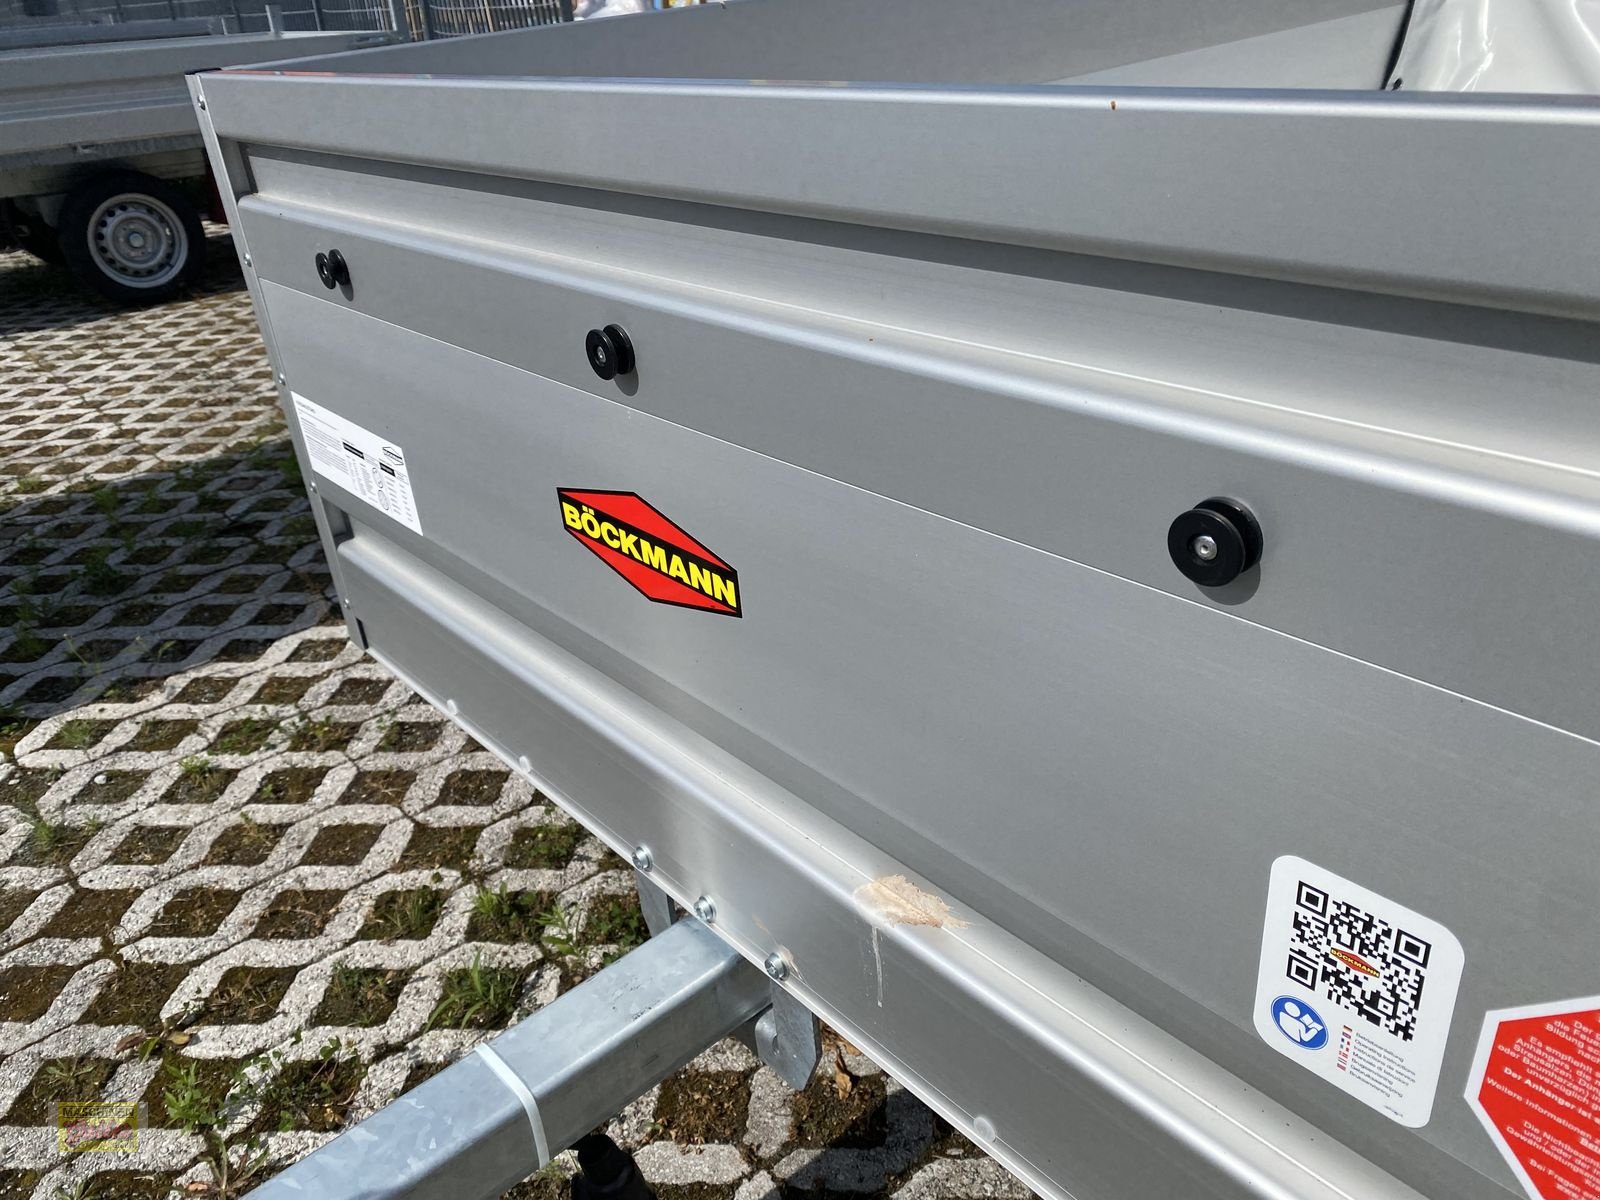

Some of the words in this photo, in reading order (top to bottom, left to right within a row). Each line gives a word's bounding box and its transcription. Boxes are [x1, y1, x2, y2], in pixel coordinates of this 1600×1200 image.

[562, 501, 737, 608] BÖCKMANN
[1331, 949, 1380, 977] BÖCKMANN
[1545, 1023, 1585, 1049] Bildung
[1554, 1020, 1570, 1032] die
[1574, 1020, 1594, 1035] Der
[1498, 1045, 1520, 1060] oder
[1530, 1036, 1543, 1048] Es
[1545, 1045, 1592, 1074] empfiehlt
[1526, 1067, 1589, 1105] unverzüglich
[1576, 1069, 1592, 1081] die
[1503, 1066, 1522, 1081] Der
[1524, 1079, 1576, 1110] Anhänger
[1578, 1107, 1592, 1120] ist
[1487, 1077, 1523, 1102] Weitere
[1526, 1099, 1592, 1140] Informationen
[1523, 1121, 1540, 1135] Die
[1551, 1145, 1572, 1159] oder
